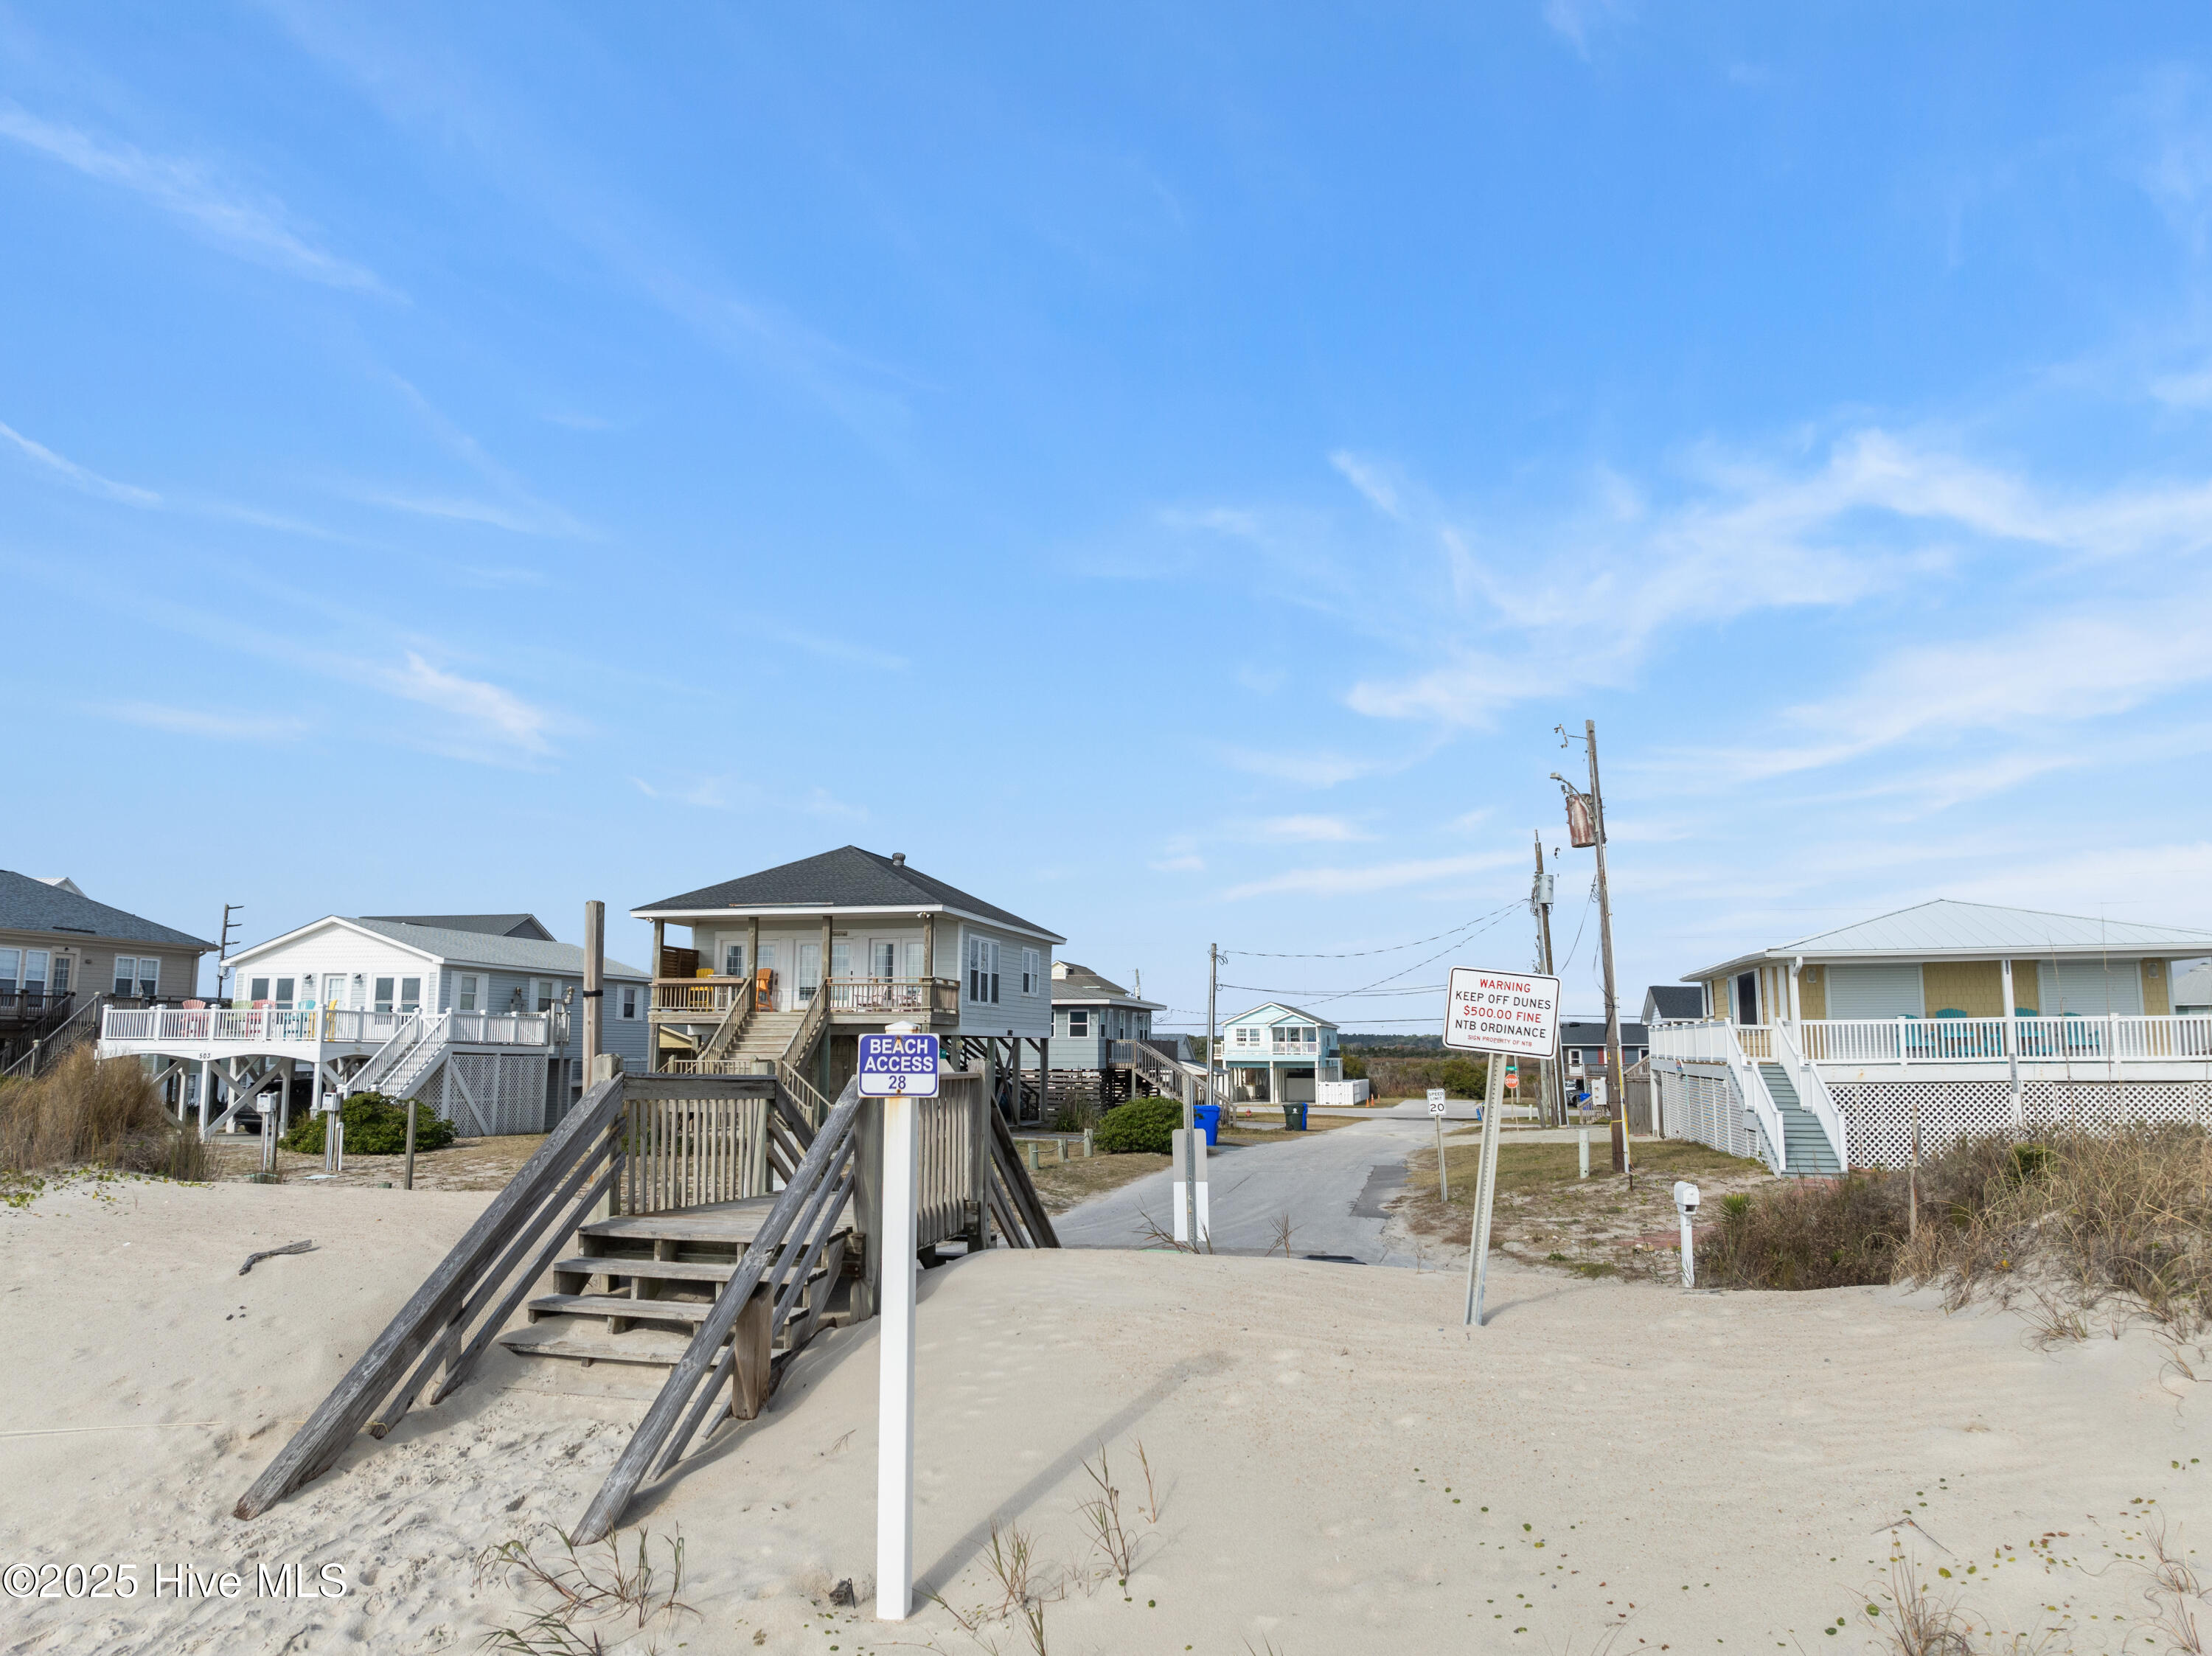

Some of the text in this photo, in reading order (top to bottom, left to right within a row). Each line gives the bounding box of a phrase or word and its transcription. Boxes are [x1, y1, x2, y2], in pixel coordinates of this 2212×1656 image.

[1480, 978, 1531, 993] WARNING
[1455, 990, 1551, 1009] KEEP OFF DUNES
[1464, 1005, 1542, 1023] $500.00 FINE
[1455, 1020, 1546, 1038] NTB ORDINANCE
[870, 1038, 928, 1054] BEACH
[1482, 1036, 1511, 1044] PROPERTY
[863, 1056, 933, 1072] ACCESS
[888, 1075, 906, 1090] 28
[1430, 1103, 1444, 1112] 20
